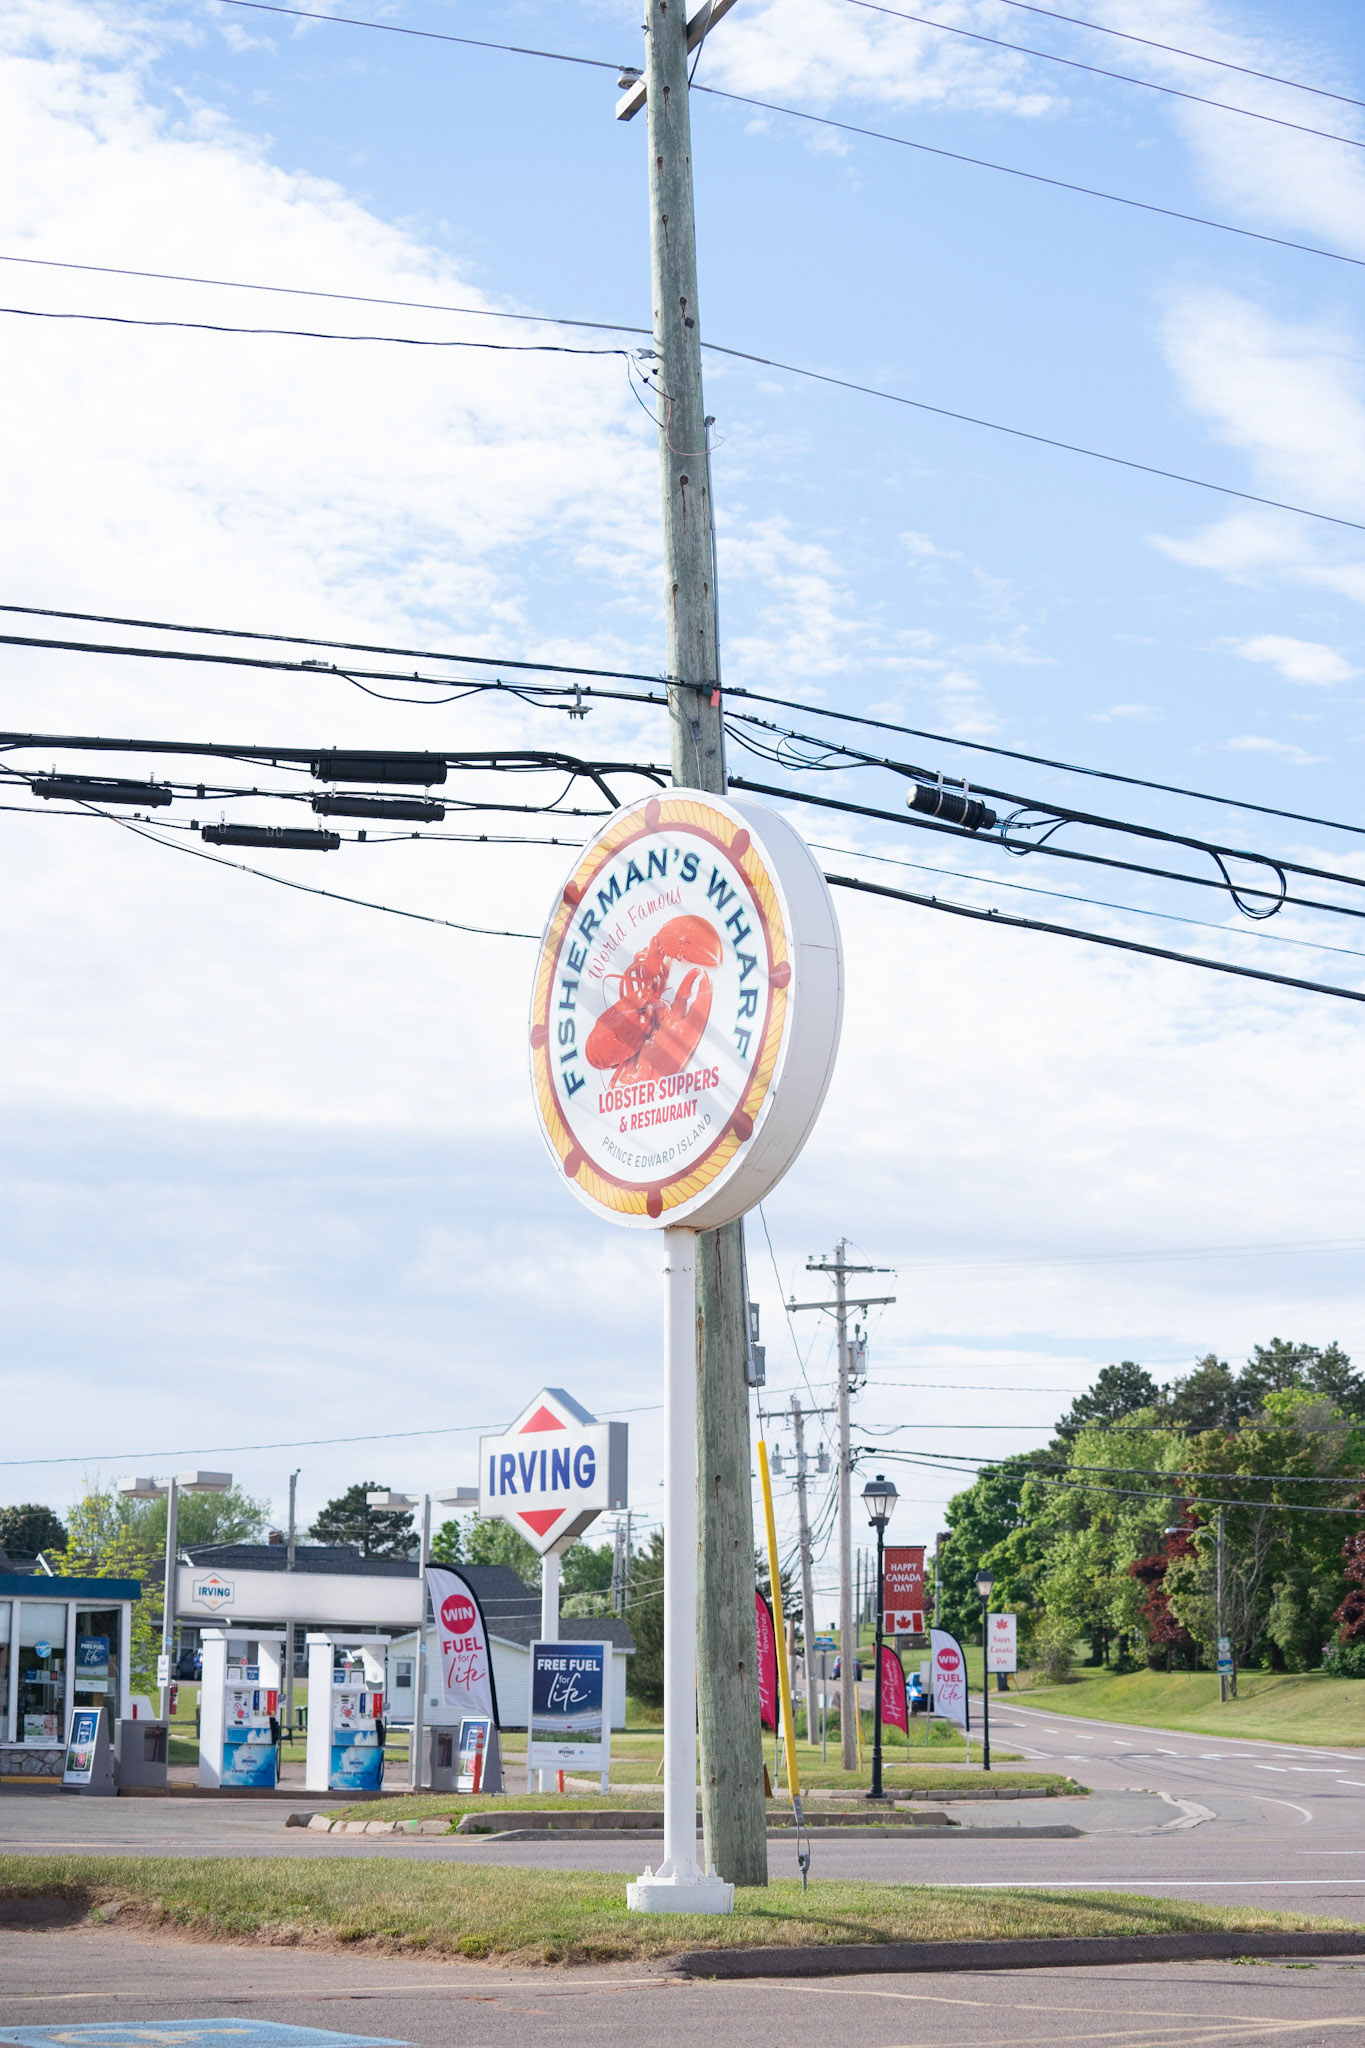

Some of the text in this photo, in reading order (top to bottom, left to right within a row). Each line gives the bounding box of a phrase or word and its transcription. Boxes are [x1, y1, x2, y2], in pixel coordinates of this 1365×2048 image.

[588, 887, 682, 979] World Famous
[558, 847, 759, 1099] FISHERMAN'S WHARF
[598, 1066, 719, 1114] LOBSTER SUPPERS
[619, 1099, 698, 1133] & RESTAURANT
[602, 1113, 711, 1168] PRINCE EDWARD ISLAND
[489, 1444, 596, 1497] IRVING
[890, 1563, 917, 1572] HAPPY
[885, 1573, 921, 1582] CANADA
[198, 1586, 231, 1597] IRVING
[893, 1584, 913, 1592] DAY!
[442, 1606, 473, 1622] WIN
[443, 1636, 483, 1655] FUEL
[457, 1654, 470, 1663] for
[537, 1658, 600, 1672] FREE FUEL
[938, 1655, 959, 1664] WIN
[447, 1653, 486, 1691] life
[559, 1675, 570, 1684] for
[937, 1673, 963, 1683] FUEL
[547, 1672, 588, 1712] life
[937, 1683, 963, 1704] life
